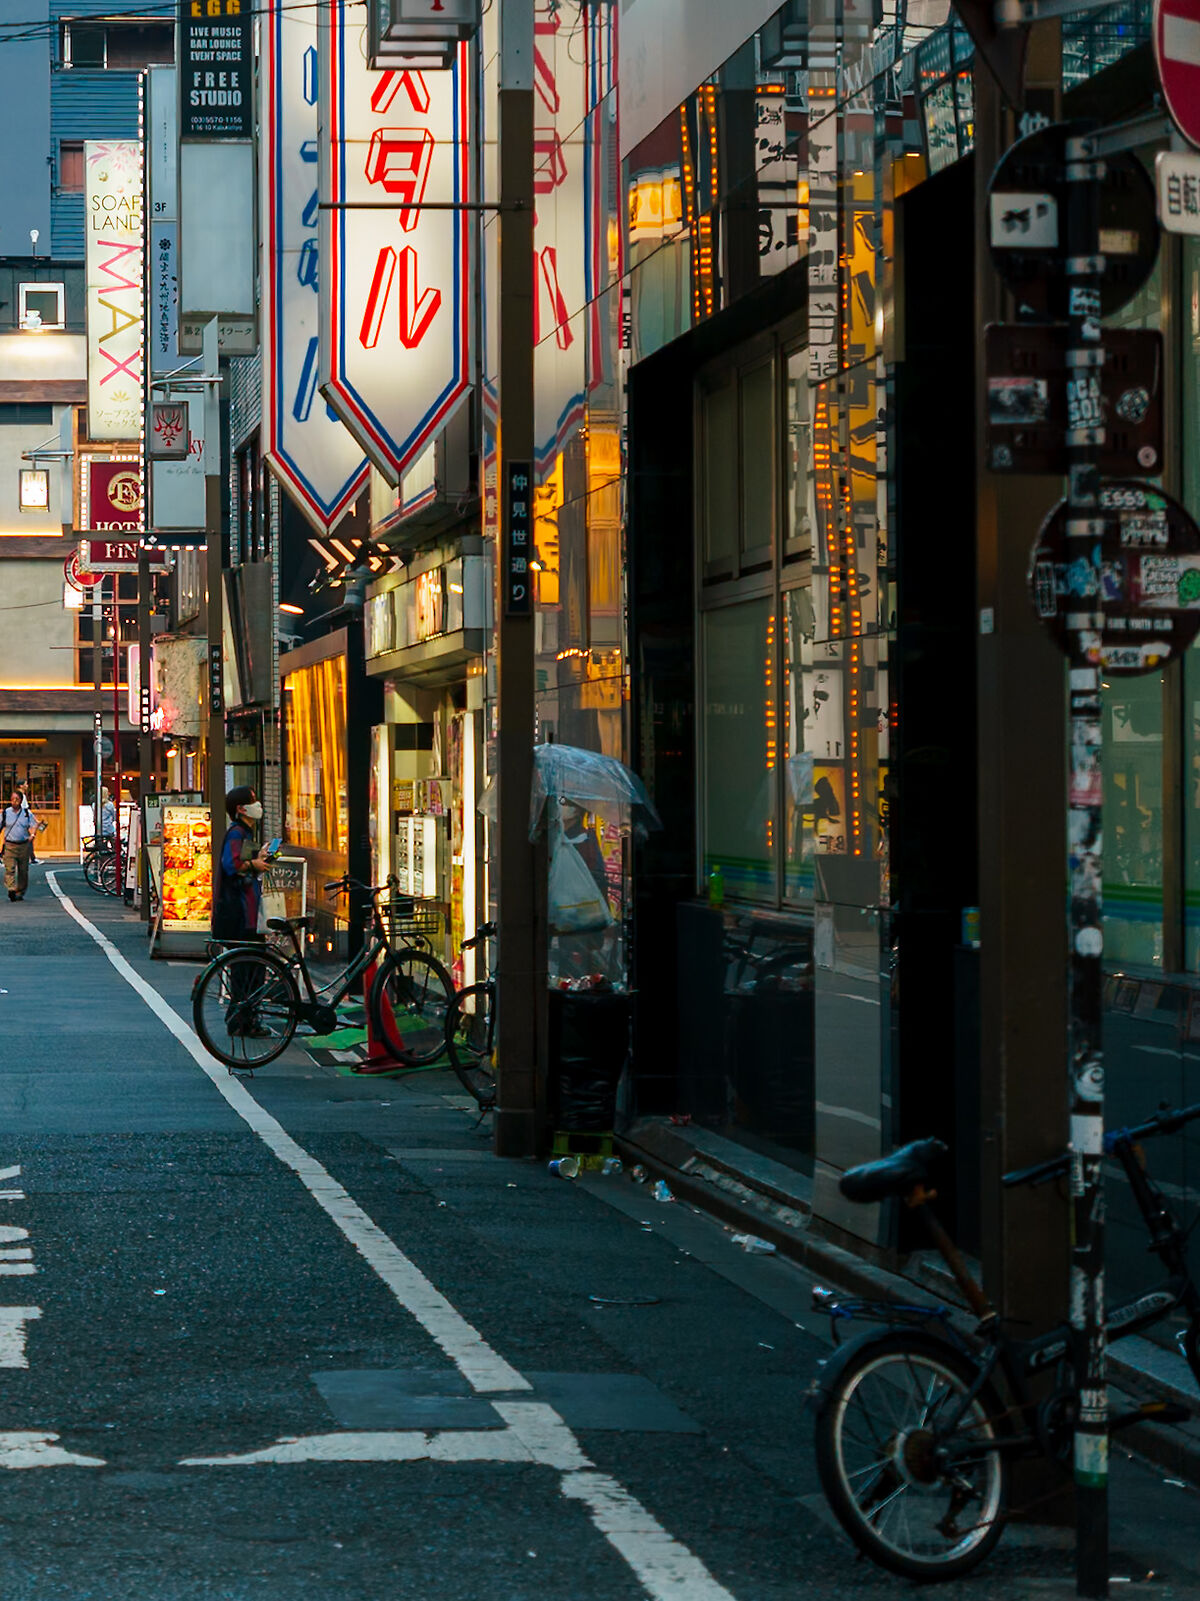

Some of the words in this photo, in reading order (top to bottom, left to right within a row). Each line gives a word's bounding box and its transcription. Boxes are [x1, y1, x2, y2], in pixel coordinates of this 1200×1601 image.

[190, 27, 209, 37] LIVE
[211, 27, 242, 37] MUSIC
[209, 39, 242, 49] LOUNGE
[190, 51, 215, 61] EVENT
[216, 51, 242, 61] SPACE
[193, 71, 239, 87] FREE
[190, 90, 242, 106] STUDIO
[154, 202, 166, 212] 3F
[97, 239, 141, 386] MAX
[512, 474, 528, 601] 仲見世通り
